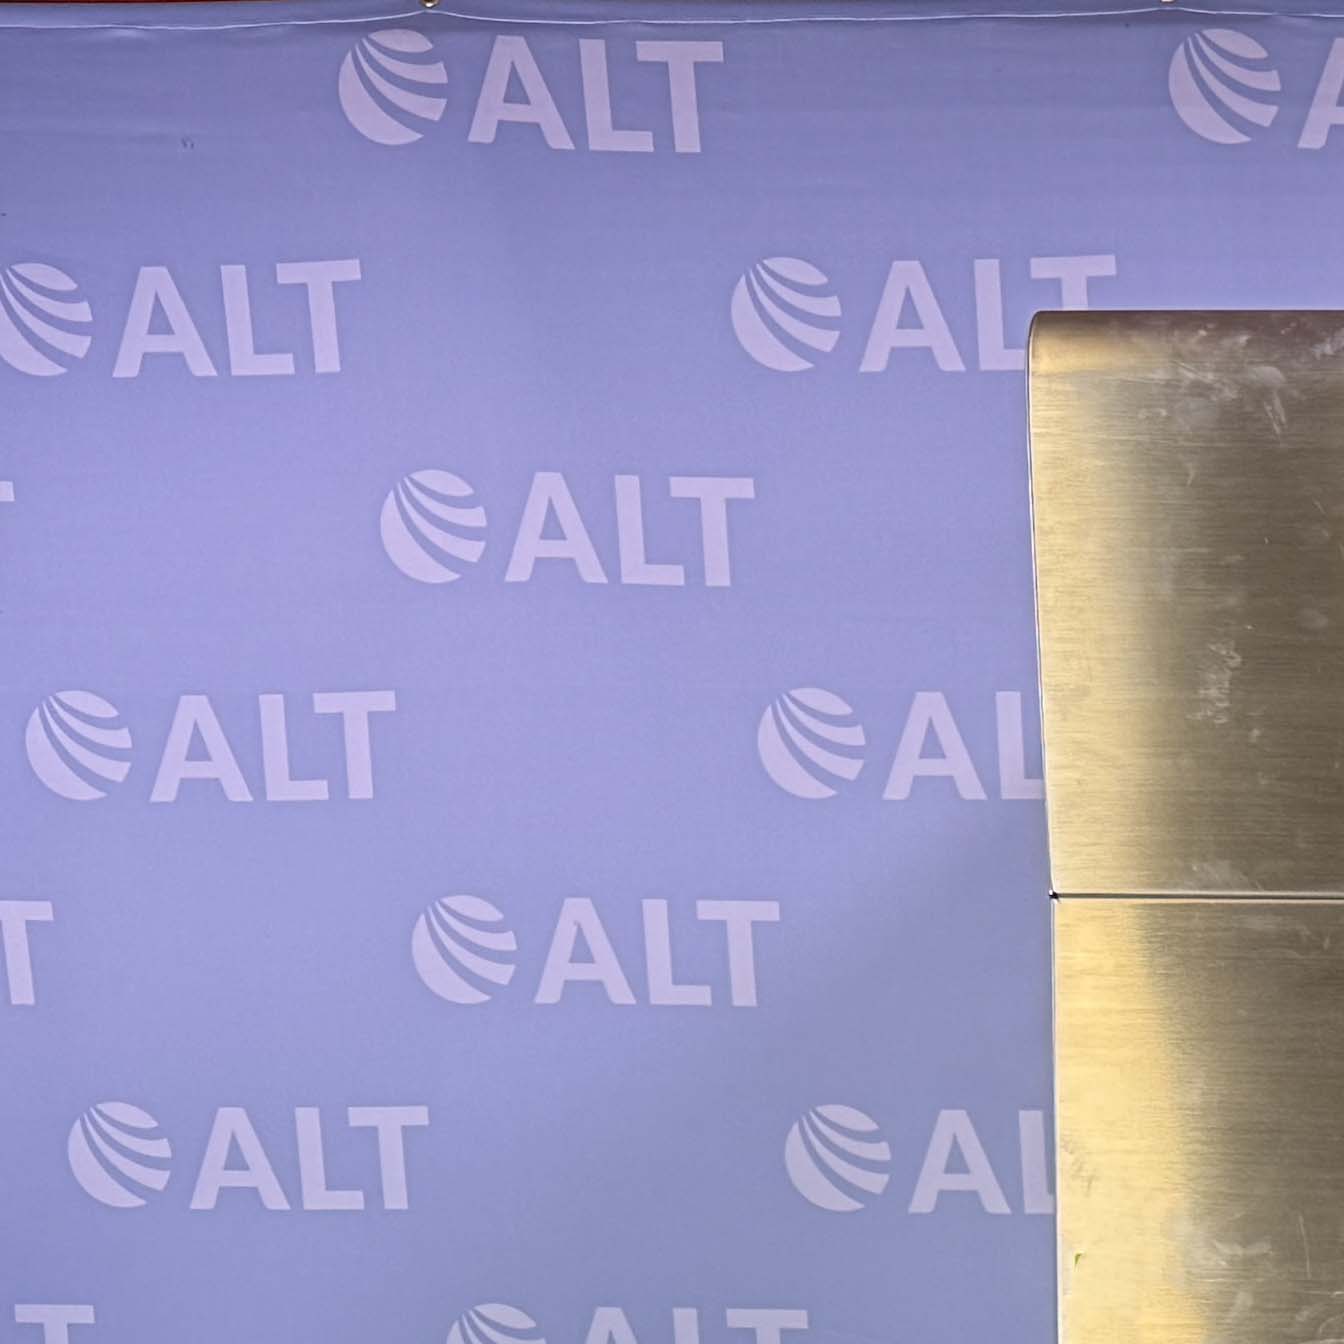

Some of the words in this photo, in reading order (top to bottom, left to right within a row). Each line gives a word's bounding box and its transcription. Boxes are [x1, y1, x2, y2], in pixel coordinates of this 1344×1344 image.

[469, 36, 724, 153] ALT
[112, 259, 362, 378] ALT
[505, 472, 756, 587] ALT
[150, 691, 397, 802] ALT
[884, 691, 1049, 800] AL
[535, 897, 781, 1007] ALT
[191, 1106, 430, 1211] ALT
[910, 1110, 1056, 1214] AL
